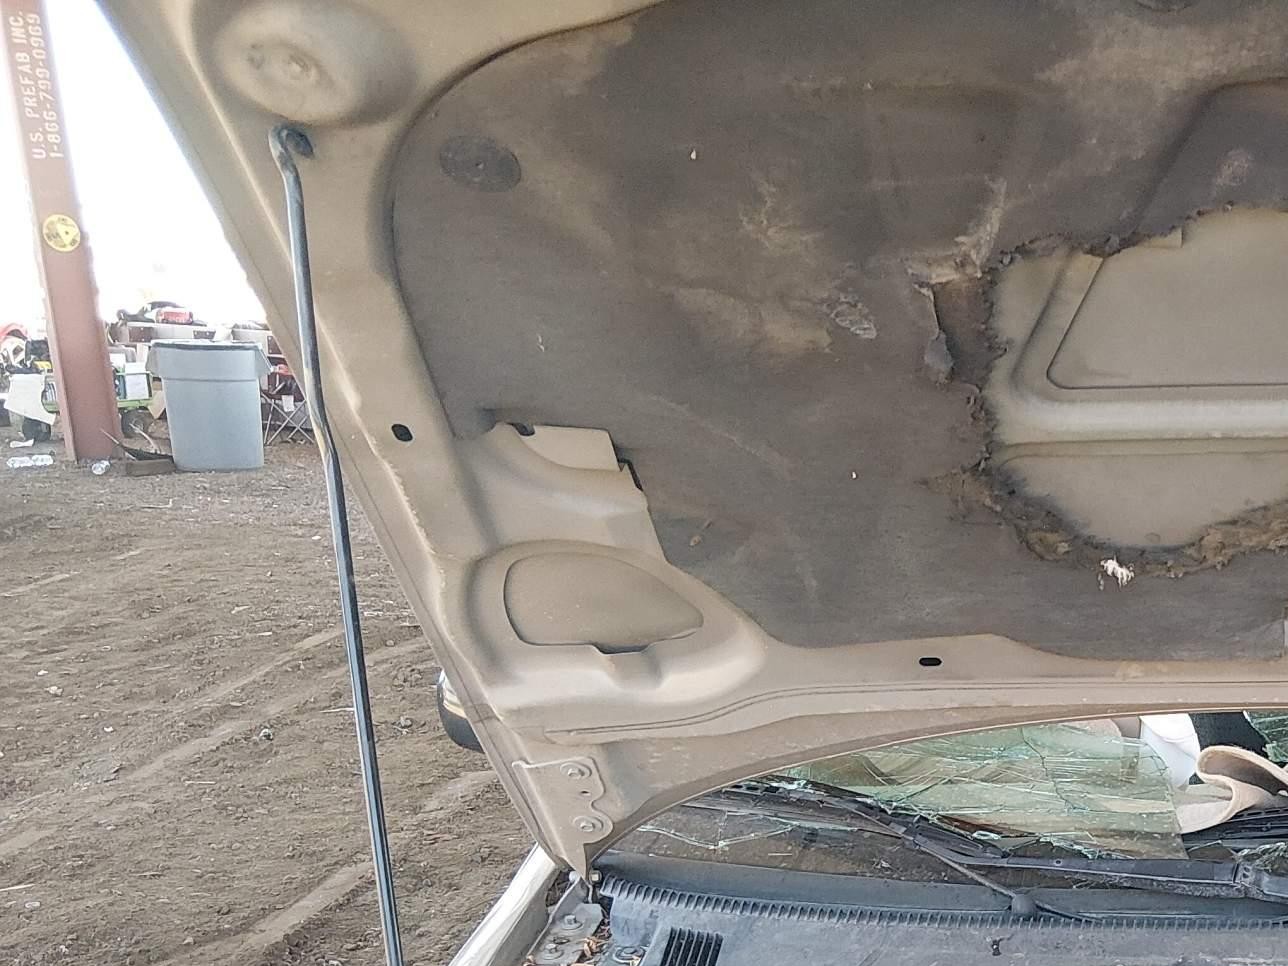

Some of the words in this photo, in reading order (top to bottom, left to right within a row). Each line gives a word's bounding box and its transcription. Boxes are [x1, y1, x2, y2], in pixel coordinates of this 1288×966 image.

[8, 11, 28, 44] INC.
[15, 51, 41, 119] PREFAB
[30, 128, 47, 160] U.S.
